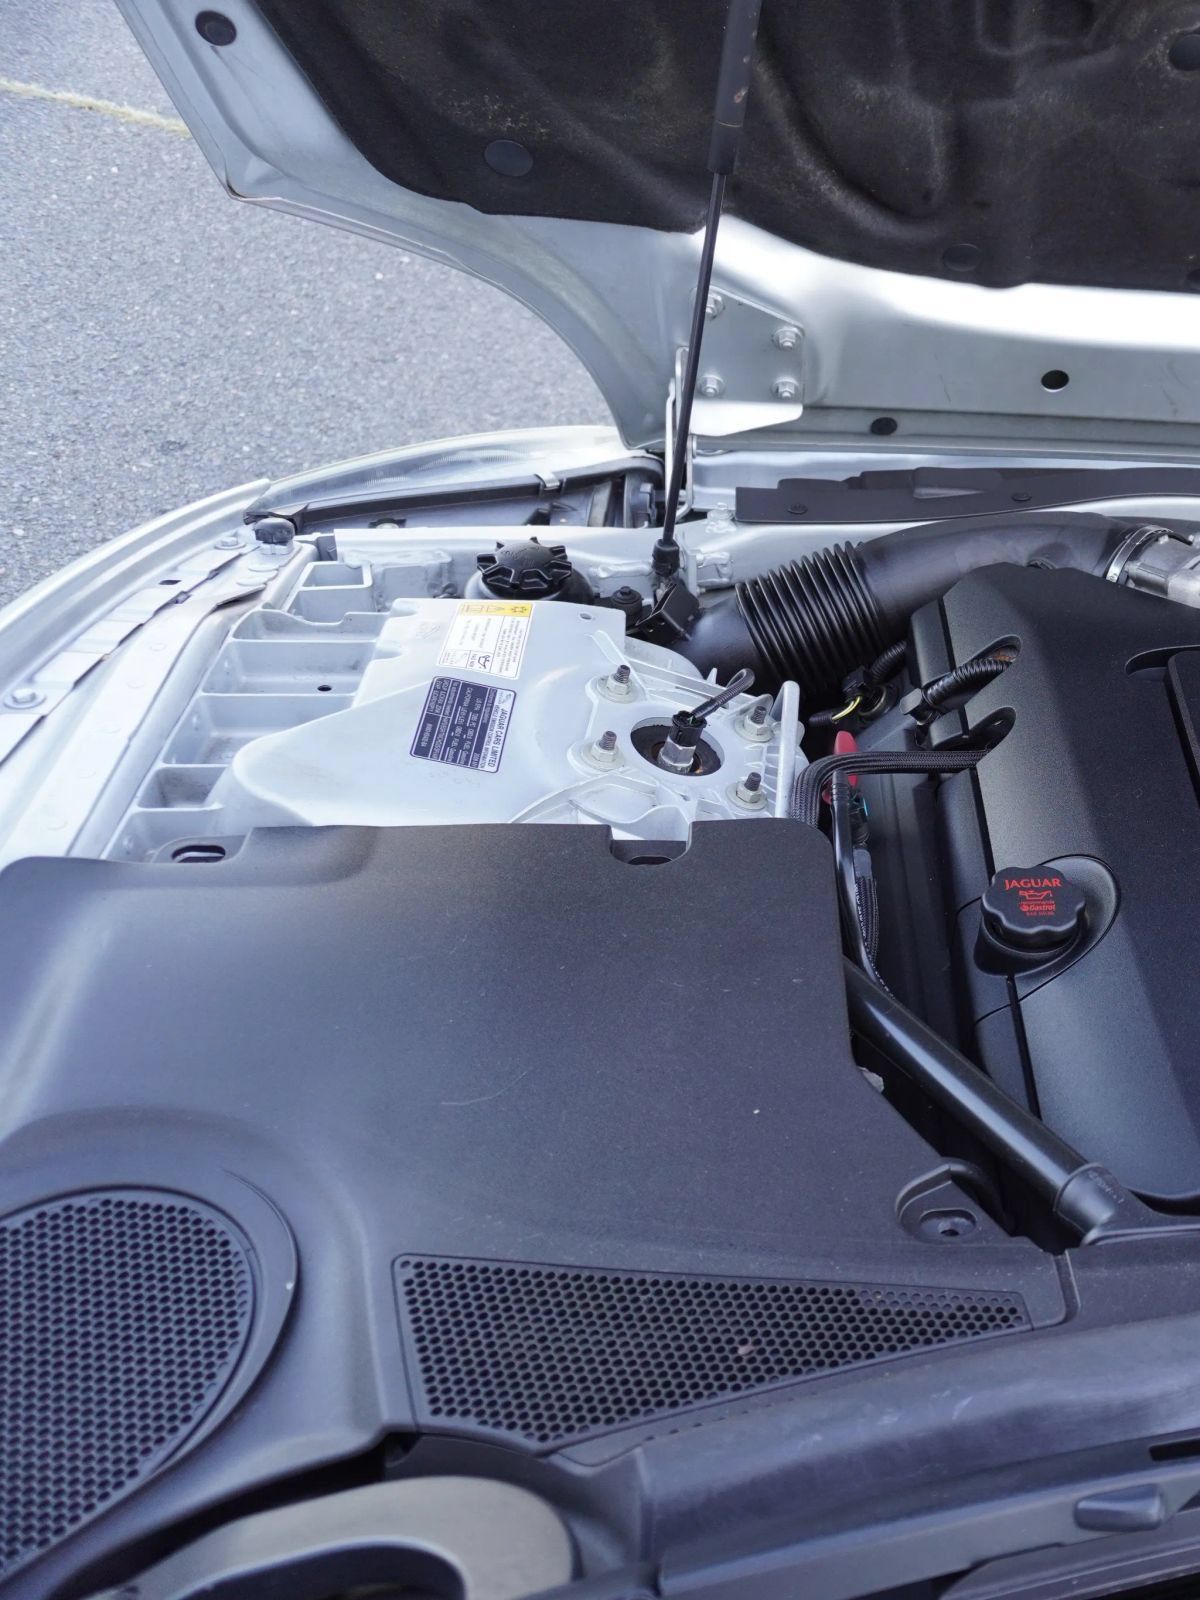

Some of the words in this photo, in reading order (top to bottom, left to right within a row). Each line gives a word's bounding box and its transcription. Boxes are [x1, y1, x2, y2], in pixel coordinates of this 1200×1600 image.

[498, 708, 508, 730] JAGUAR
[493, 730, 503, 745] CARS
[488, 745, 499, 768] LIMITED
[1004, 878, 1062, 890] JAGUAR
[1029, 904, 1056, 912] Castrol
